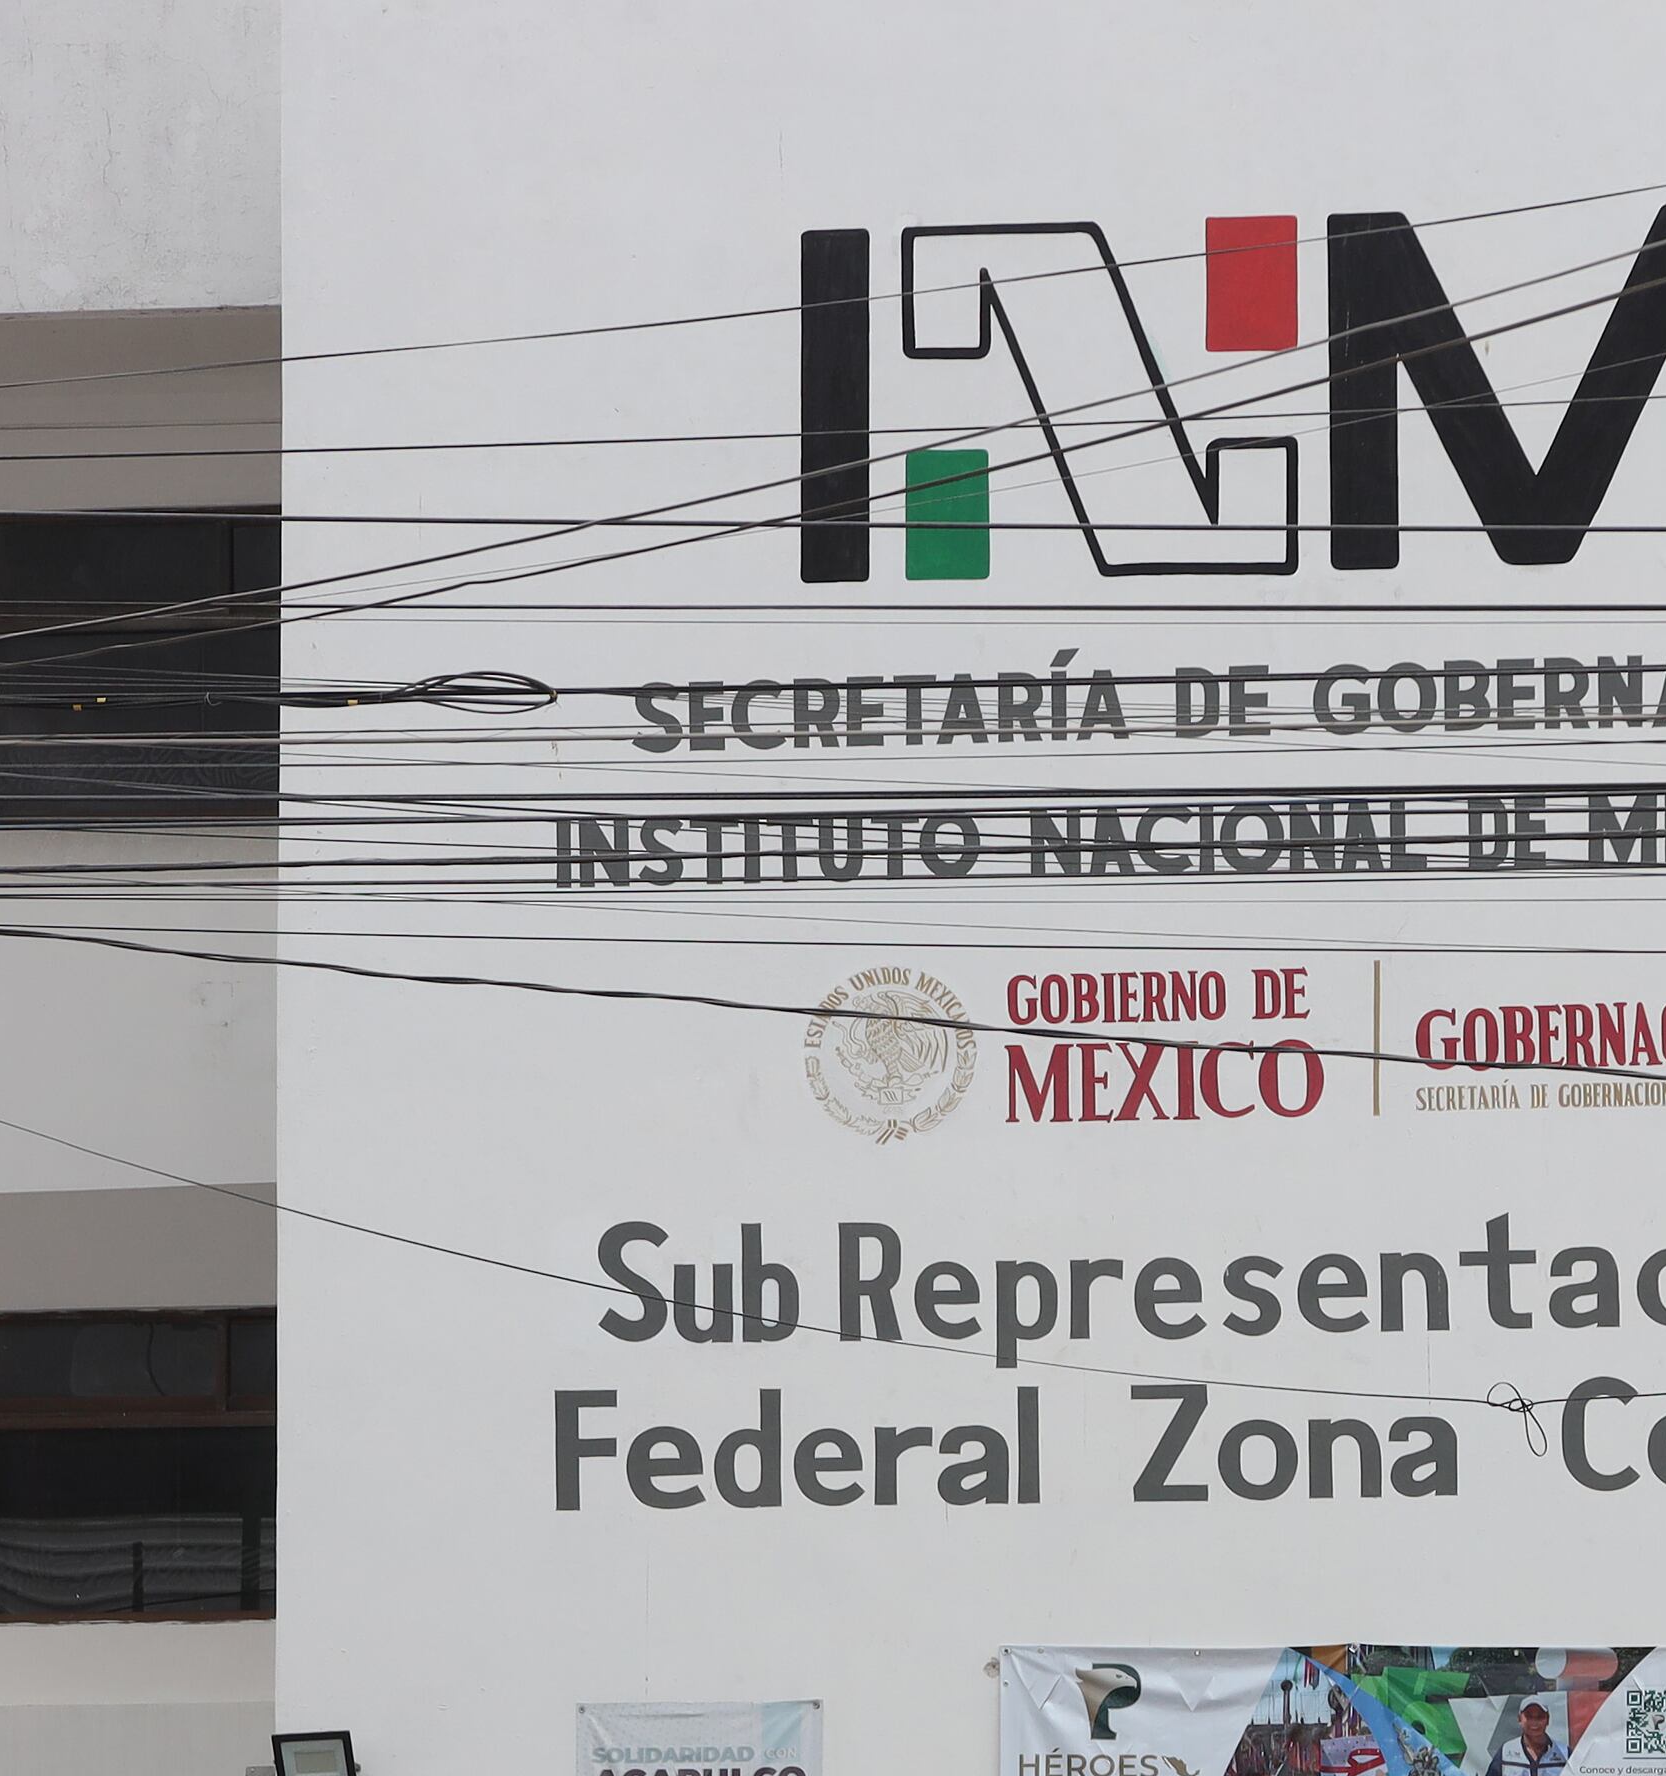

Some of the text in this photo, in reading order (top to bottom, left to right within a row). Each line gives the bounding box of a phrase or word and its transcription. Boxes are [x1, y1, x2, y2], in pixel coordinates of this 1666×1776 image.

[632, 648, 1130, 754] SECRETARÍA
[1174, 665, 1271, 738] DE
[556, 815, 981, 888] INSTITUTO
[1030, 803, 1427, 876] NACIONAL
[1467, 797, 1547, 871] DE
[848, 967, 912, 994] UNIDOS
[1006, 966, 1311, 1026] GOBIERNO DE
[1004, 1039, 1325, 1124] MEXICO
[1415, 1079, 1520, 1112] SECRETARÍA
[1530, 1084, 1549, 1109] DE
[597, 1220, 800, 1343] Sub
[554, 1386, 1041, 1511] Federal
[1130, 1383, 1459, 1502] Zona
[591, 1746, 755, 1765] SOLIDARIDAD
[1579, 1766, 1616, 1775] Conoce
[1618, 1767, 1624, 1776] y
